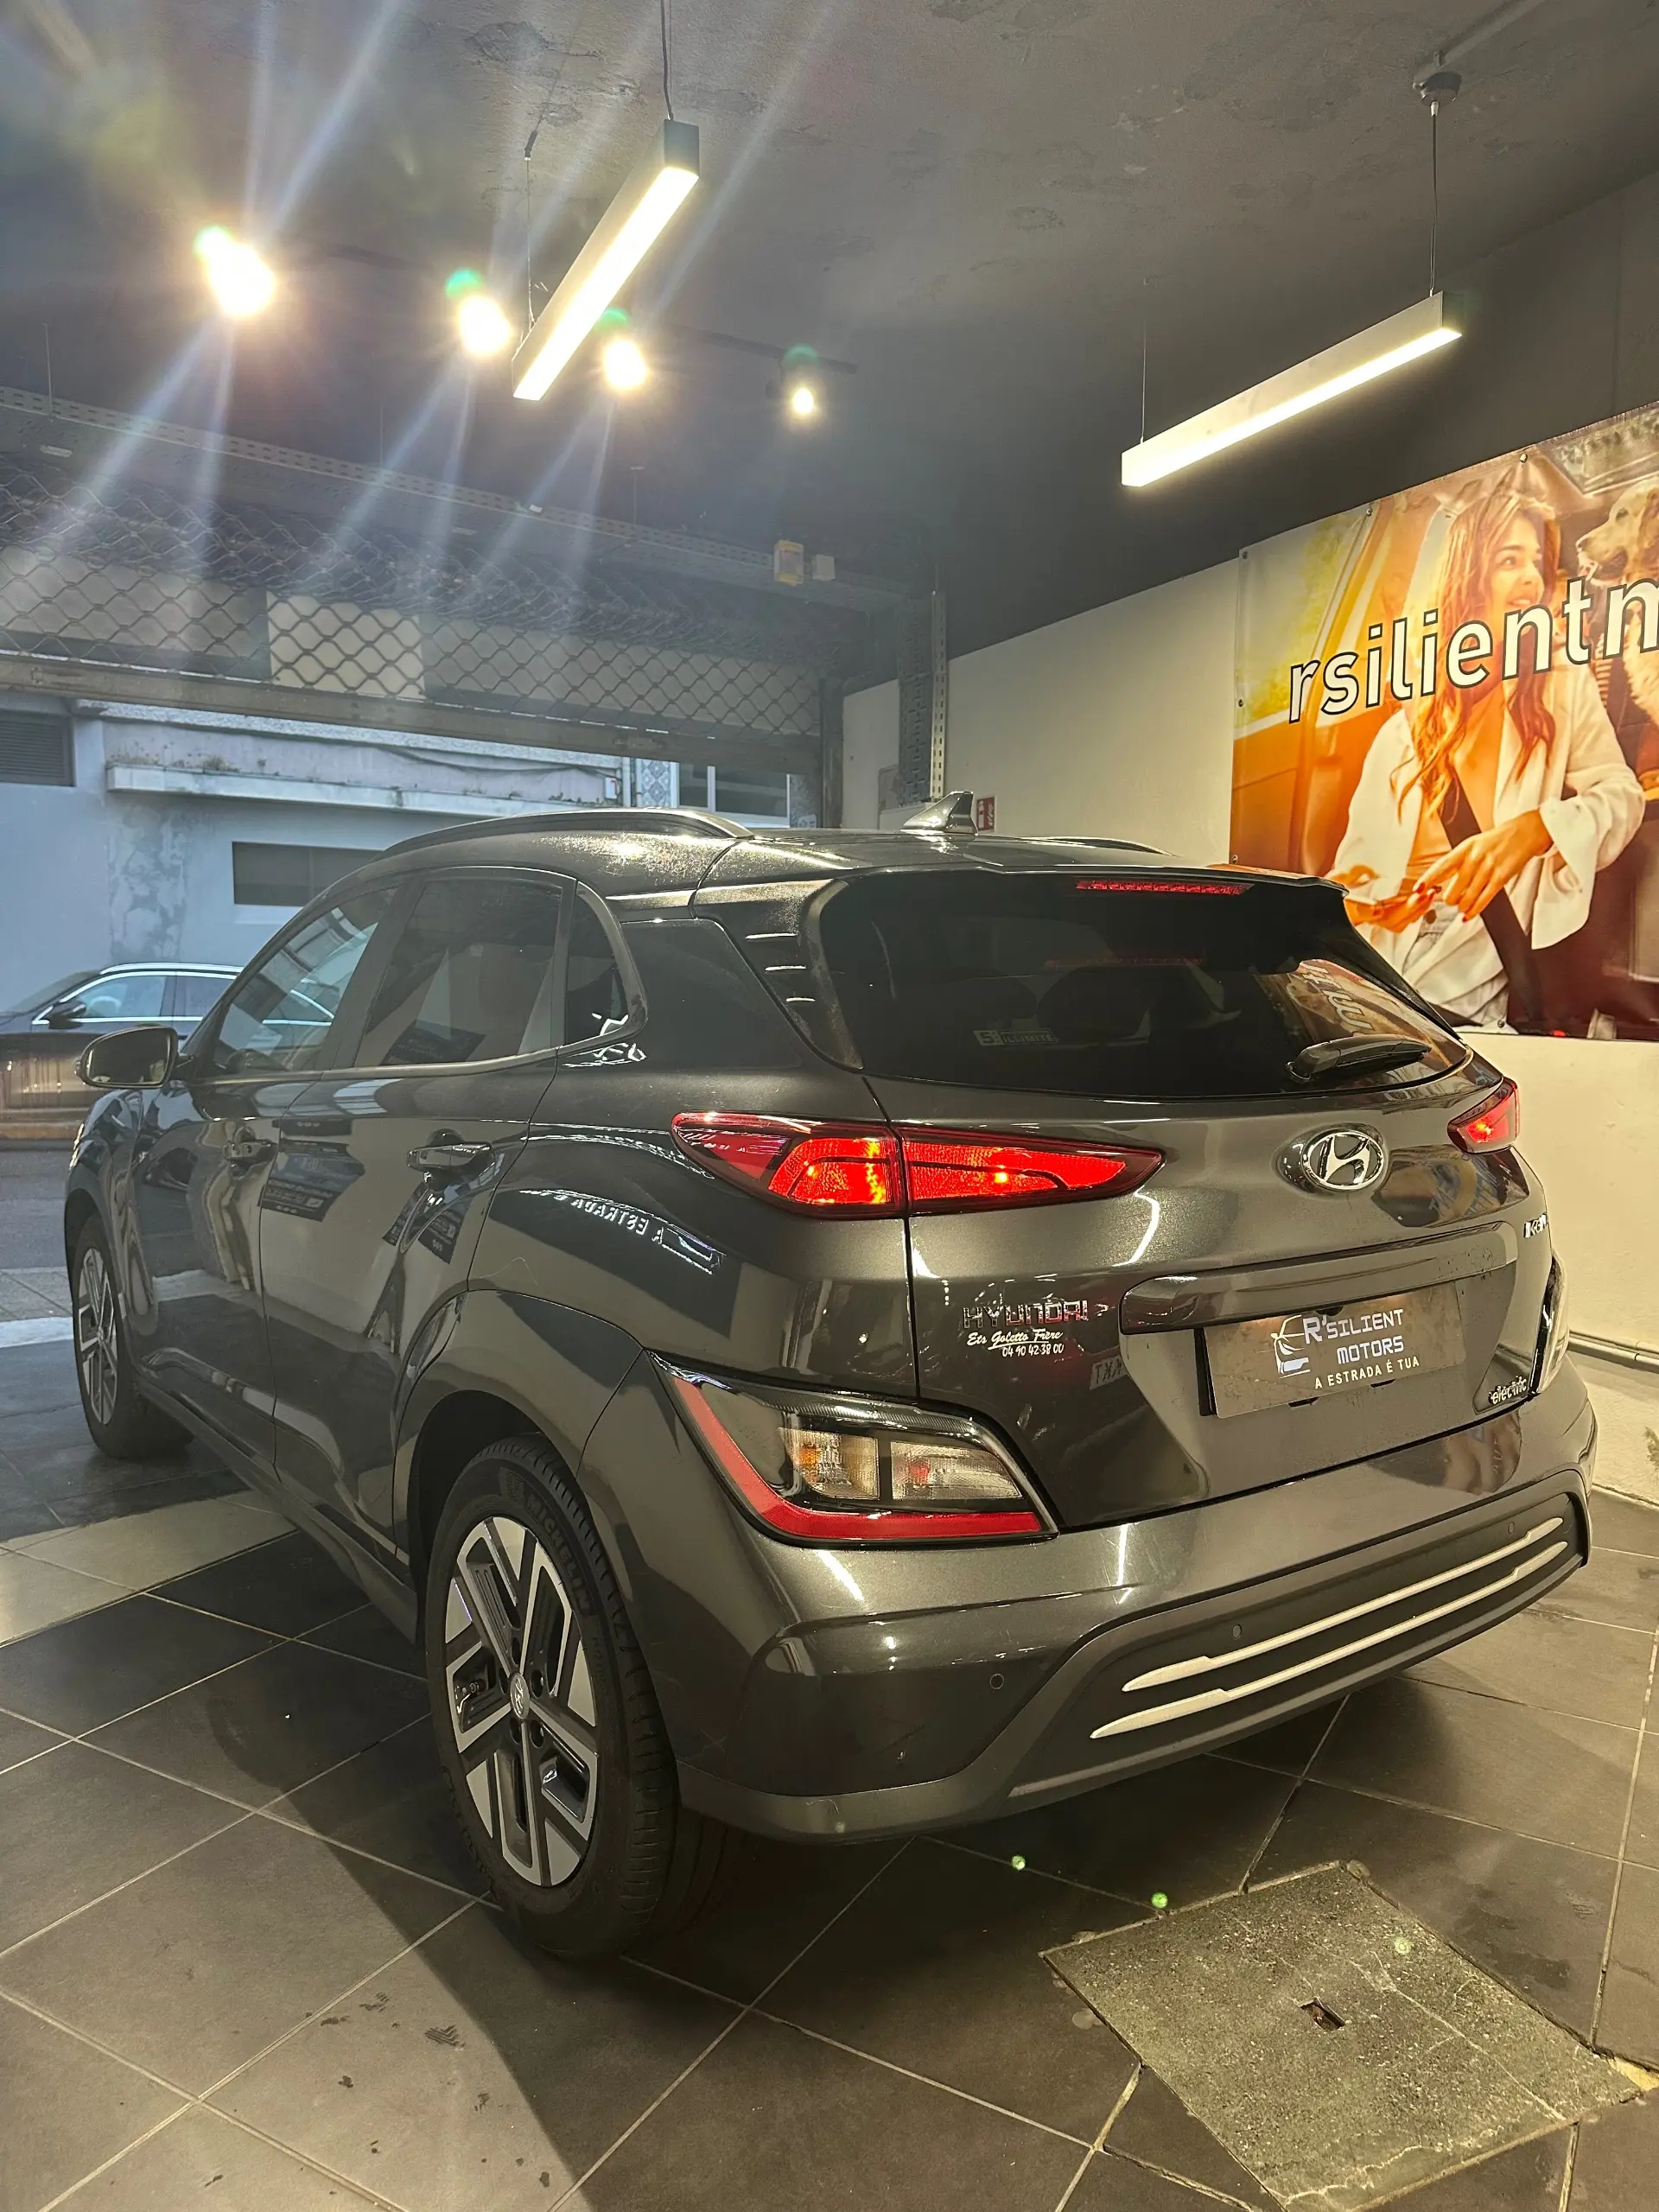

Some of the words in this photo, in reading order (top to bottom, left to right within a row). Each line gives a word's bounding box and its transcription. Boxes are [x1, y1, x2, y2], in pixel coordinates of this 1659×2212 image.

[963, 1300, 1090, 1328] HYUNDAI
[967, 1332, 987, 1346] Ets
[1002, 1346, 1014, 1357] 04
[1337, 1335, 1404, 1364] MOTORS
[1315, 1376, 1323, 1389] A
[1327, 1365, 1382, 1387] ESTRADA
[1386, 1359, 1393, 1373] É
[1397, 1356, 1420, 1370] TUA
[526, 1496, 599, 1617] MICHELIN
